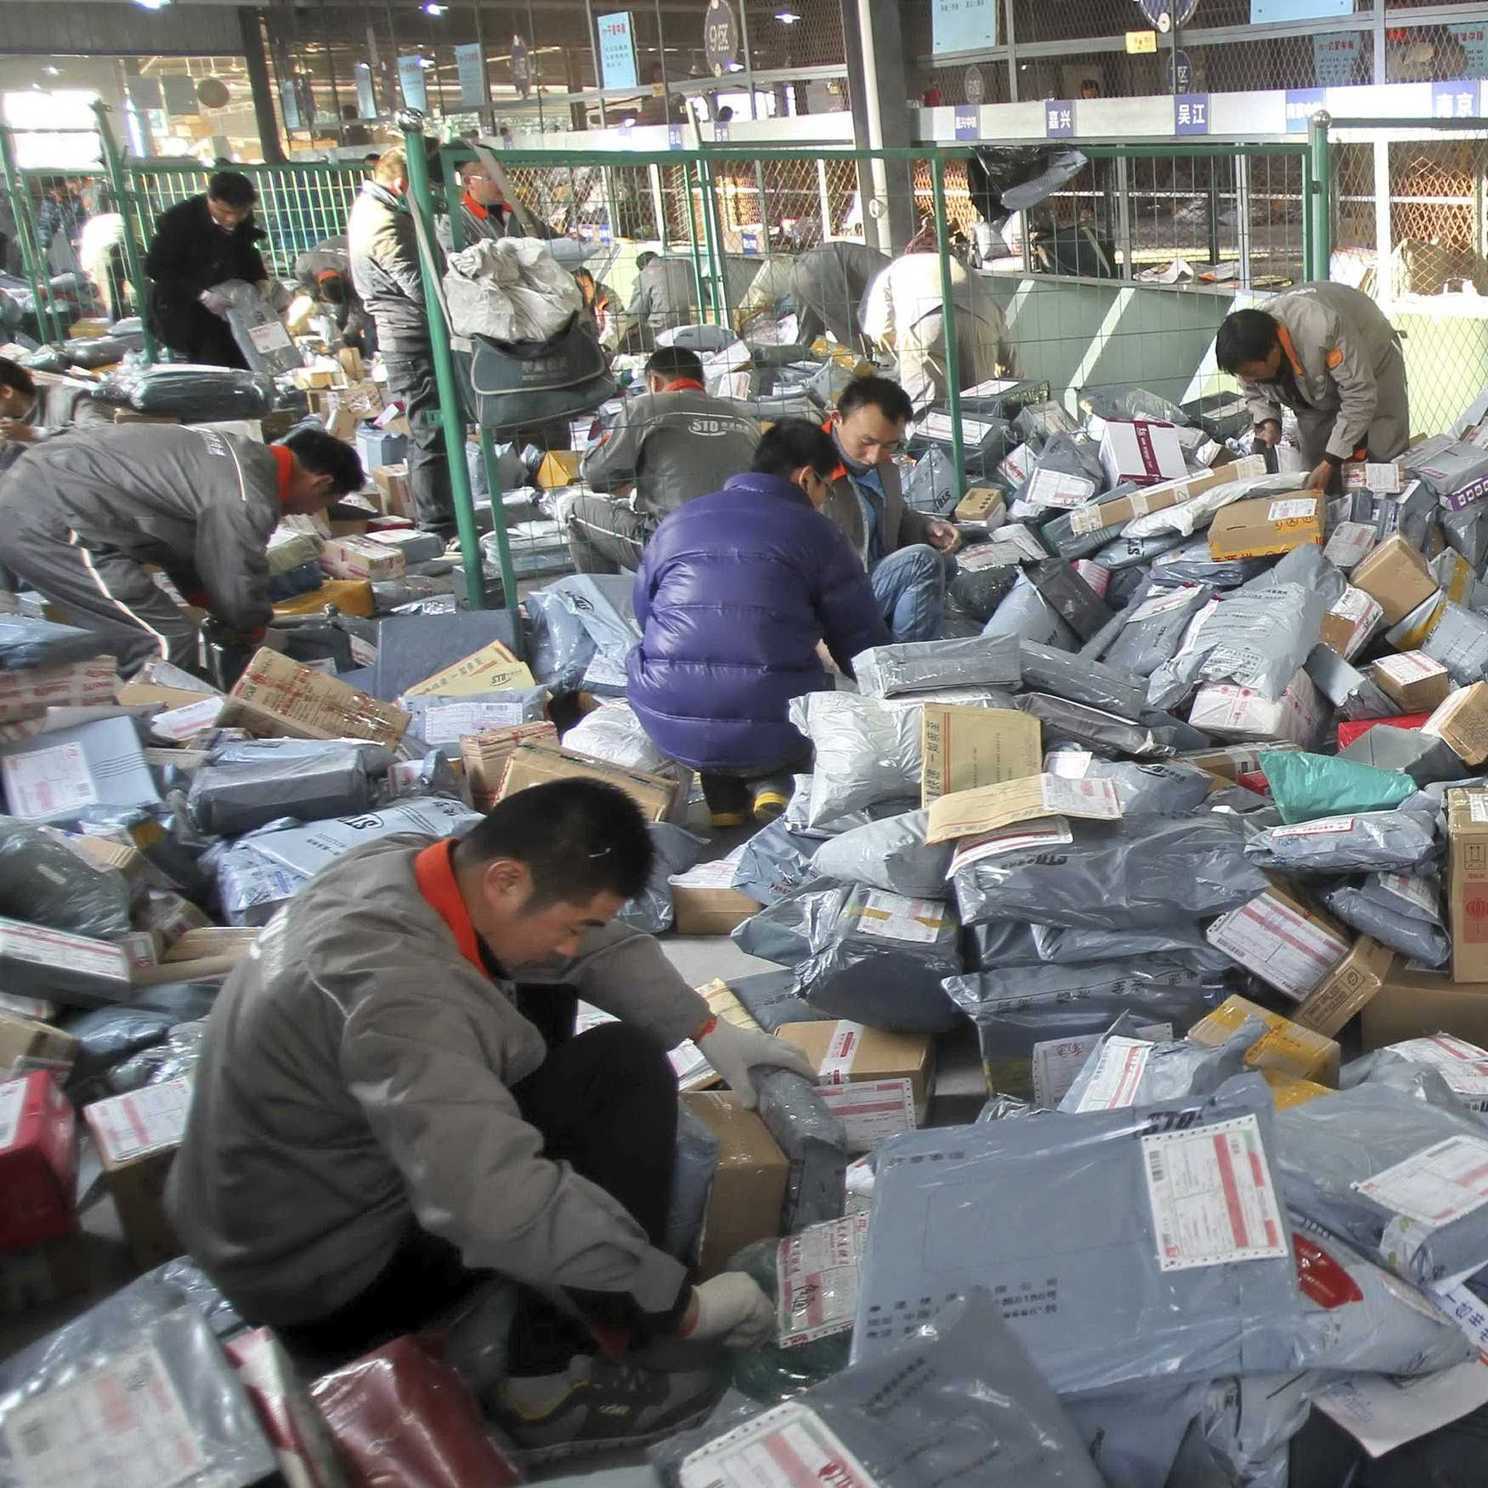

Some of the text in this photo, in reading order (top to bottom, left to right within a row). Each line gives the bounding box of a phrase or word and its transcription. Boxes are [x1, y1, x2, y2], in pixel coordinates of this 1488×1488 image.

[1048, 109, 1072, 130] 嘉兴
[1177, 103, 1205, 126] 吴江
[691, 419, 719, 433] STO
